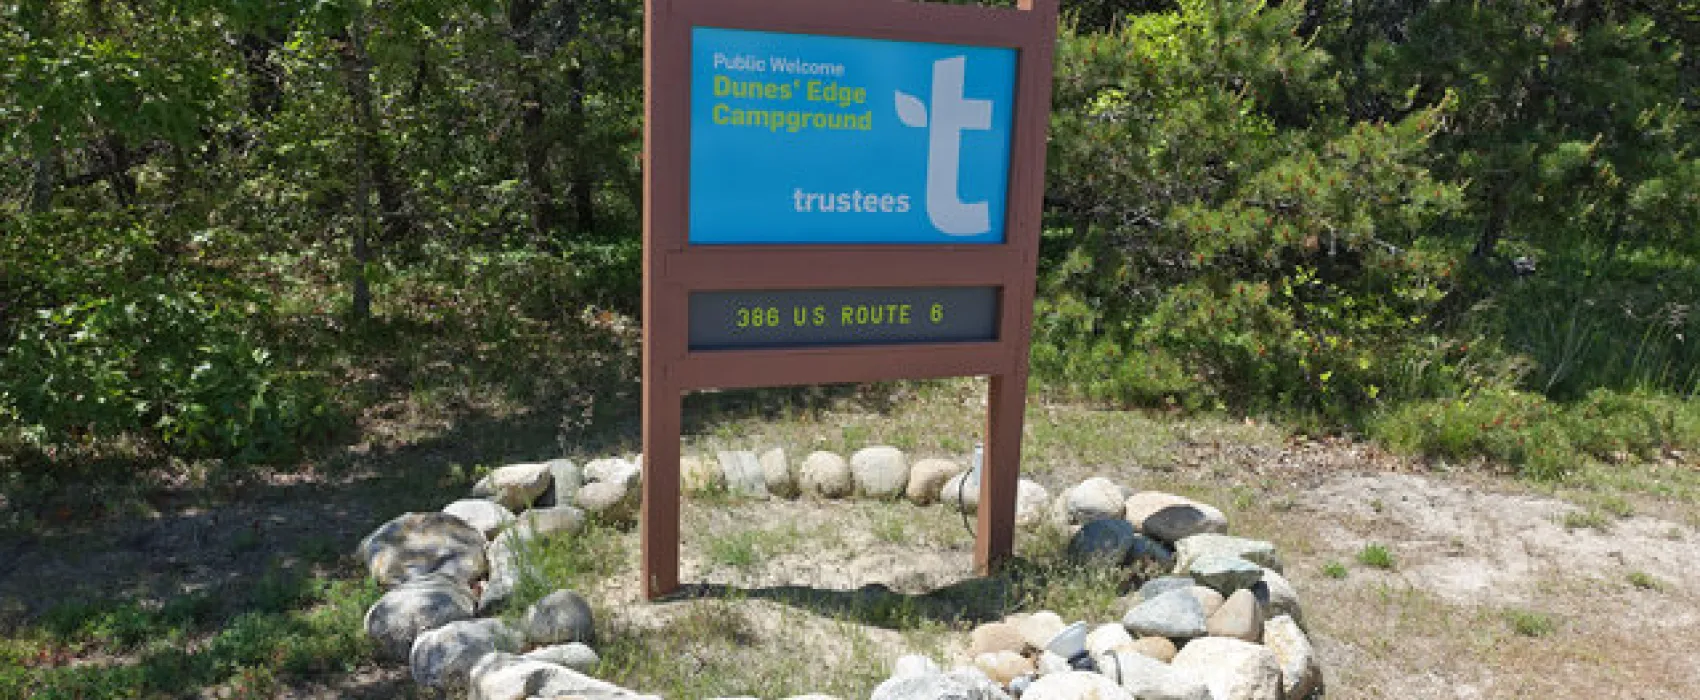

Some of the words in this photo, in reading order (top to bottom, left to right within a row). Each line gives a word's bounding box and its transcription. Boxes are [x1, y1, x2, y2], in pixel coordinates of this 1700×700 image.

[713, 52, 766, 72] Public
[770, 55, 845, 77] Welcome
[807, 81, 867, 108] Edge
[712, 104, 872, 133] Campground
[793, 188, 911, 213] trustees
[736, 306, 779, 327] 386
[841, 304, 911, 324] ROUTE
[930, 303, 944, 322] 6
